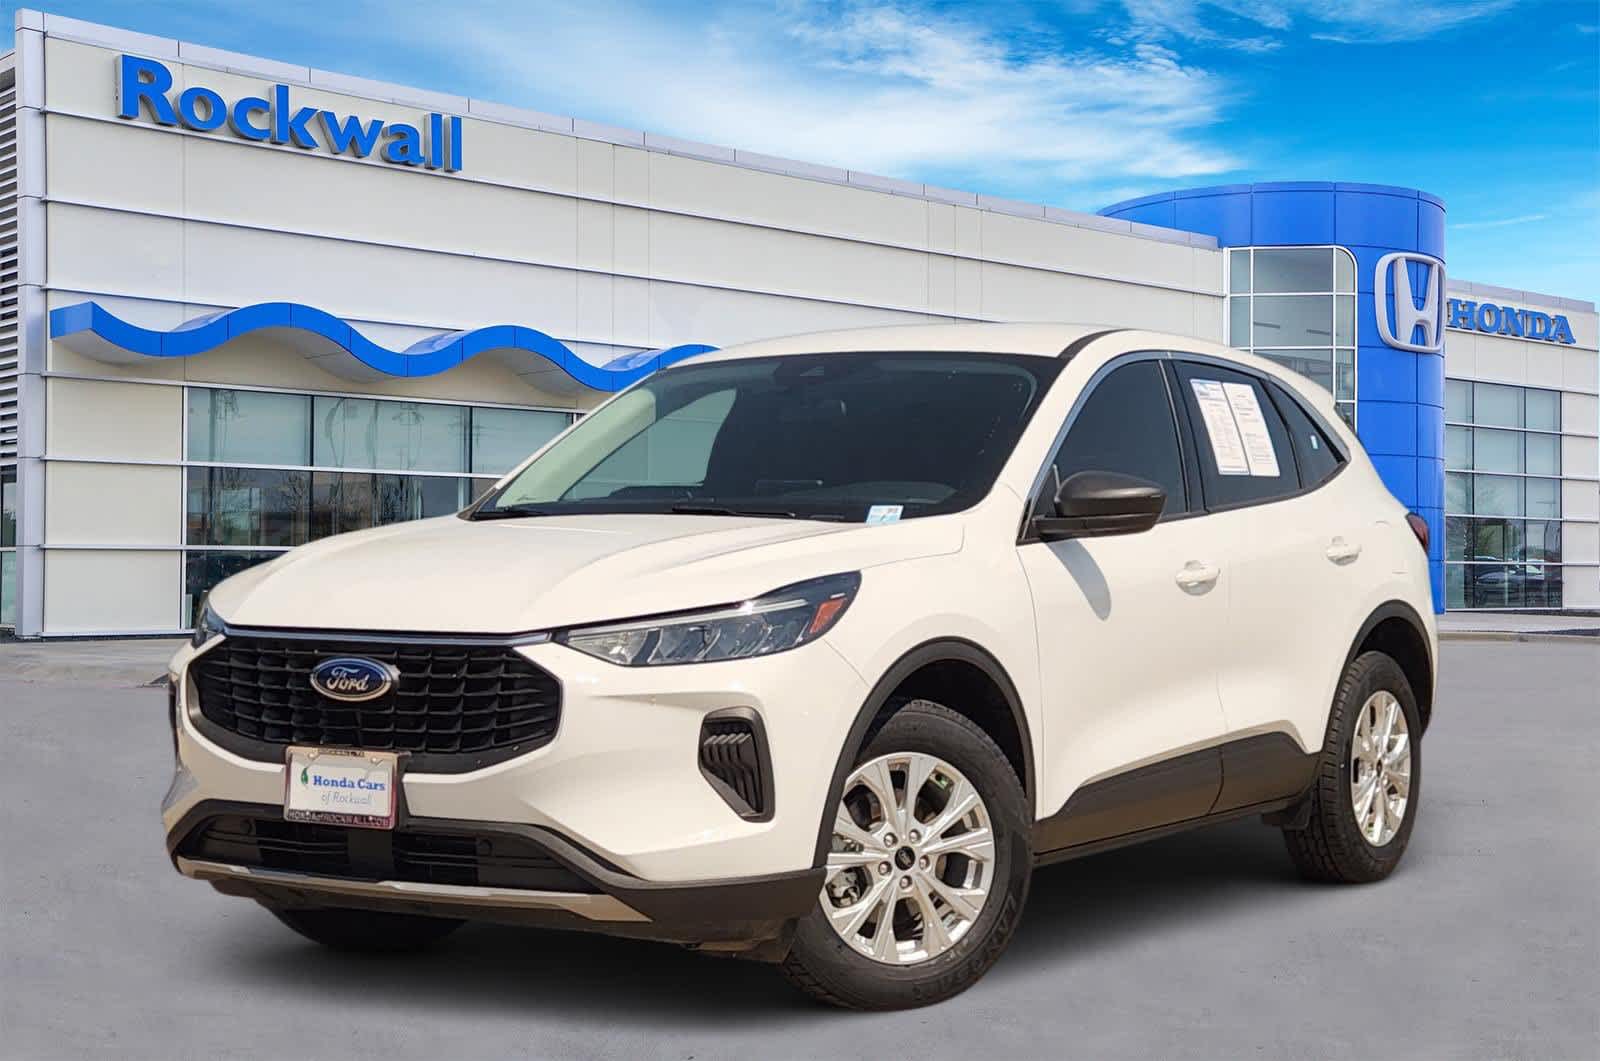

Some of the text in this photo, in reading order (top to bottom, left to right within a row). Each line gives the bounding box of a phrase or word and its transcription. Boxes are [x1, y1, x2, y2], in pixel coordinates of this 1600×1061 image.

[117, 53, 463, 172] Rockwall
[1447, 298, 1577, 344] HONDA
[326, 666, 370, 691] Ford
[313, 775, 386, 792] Honda Cars
